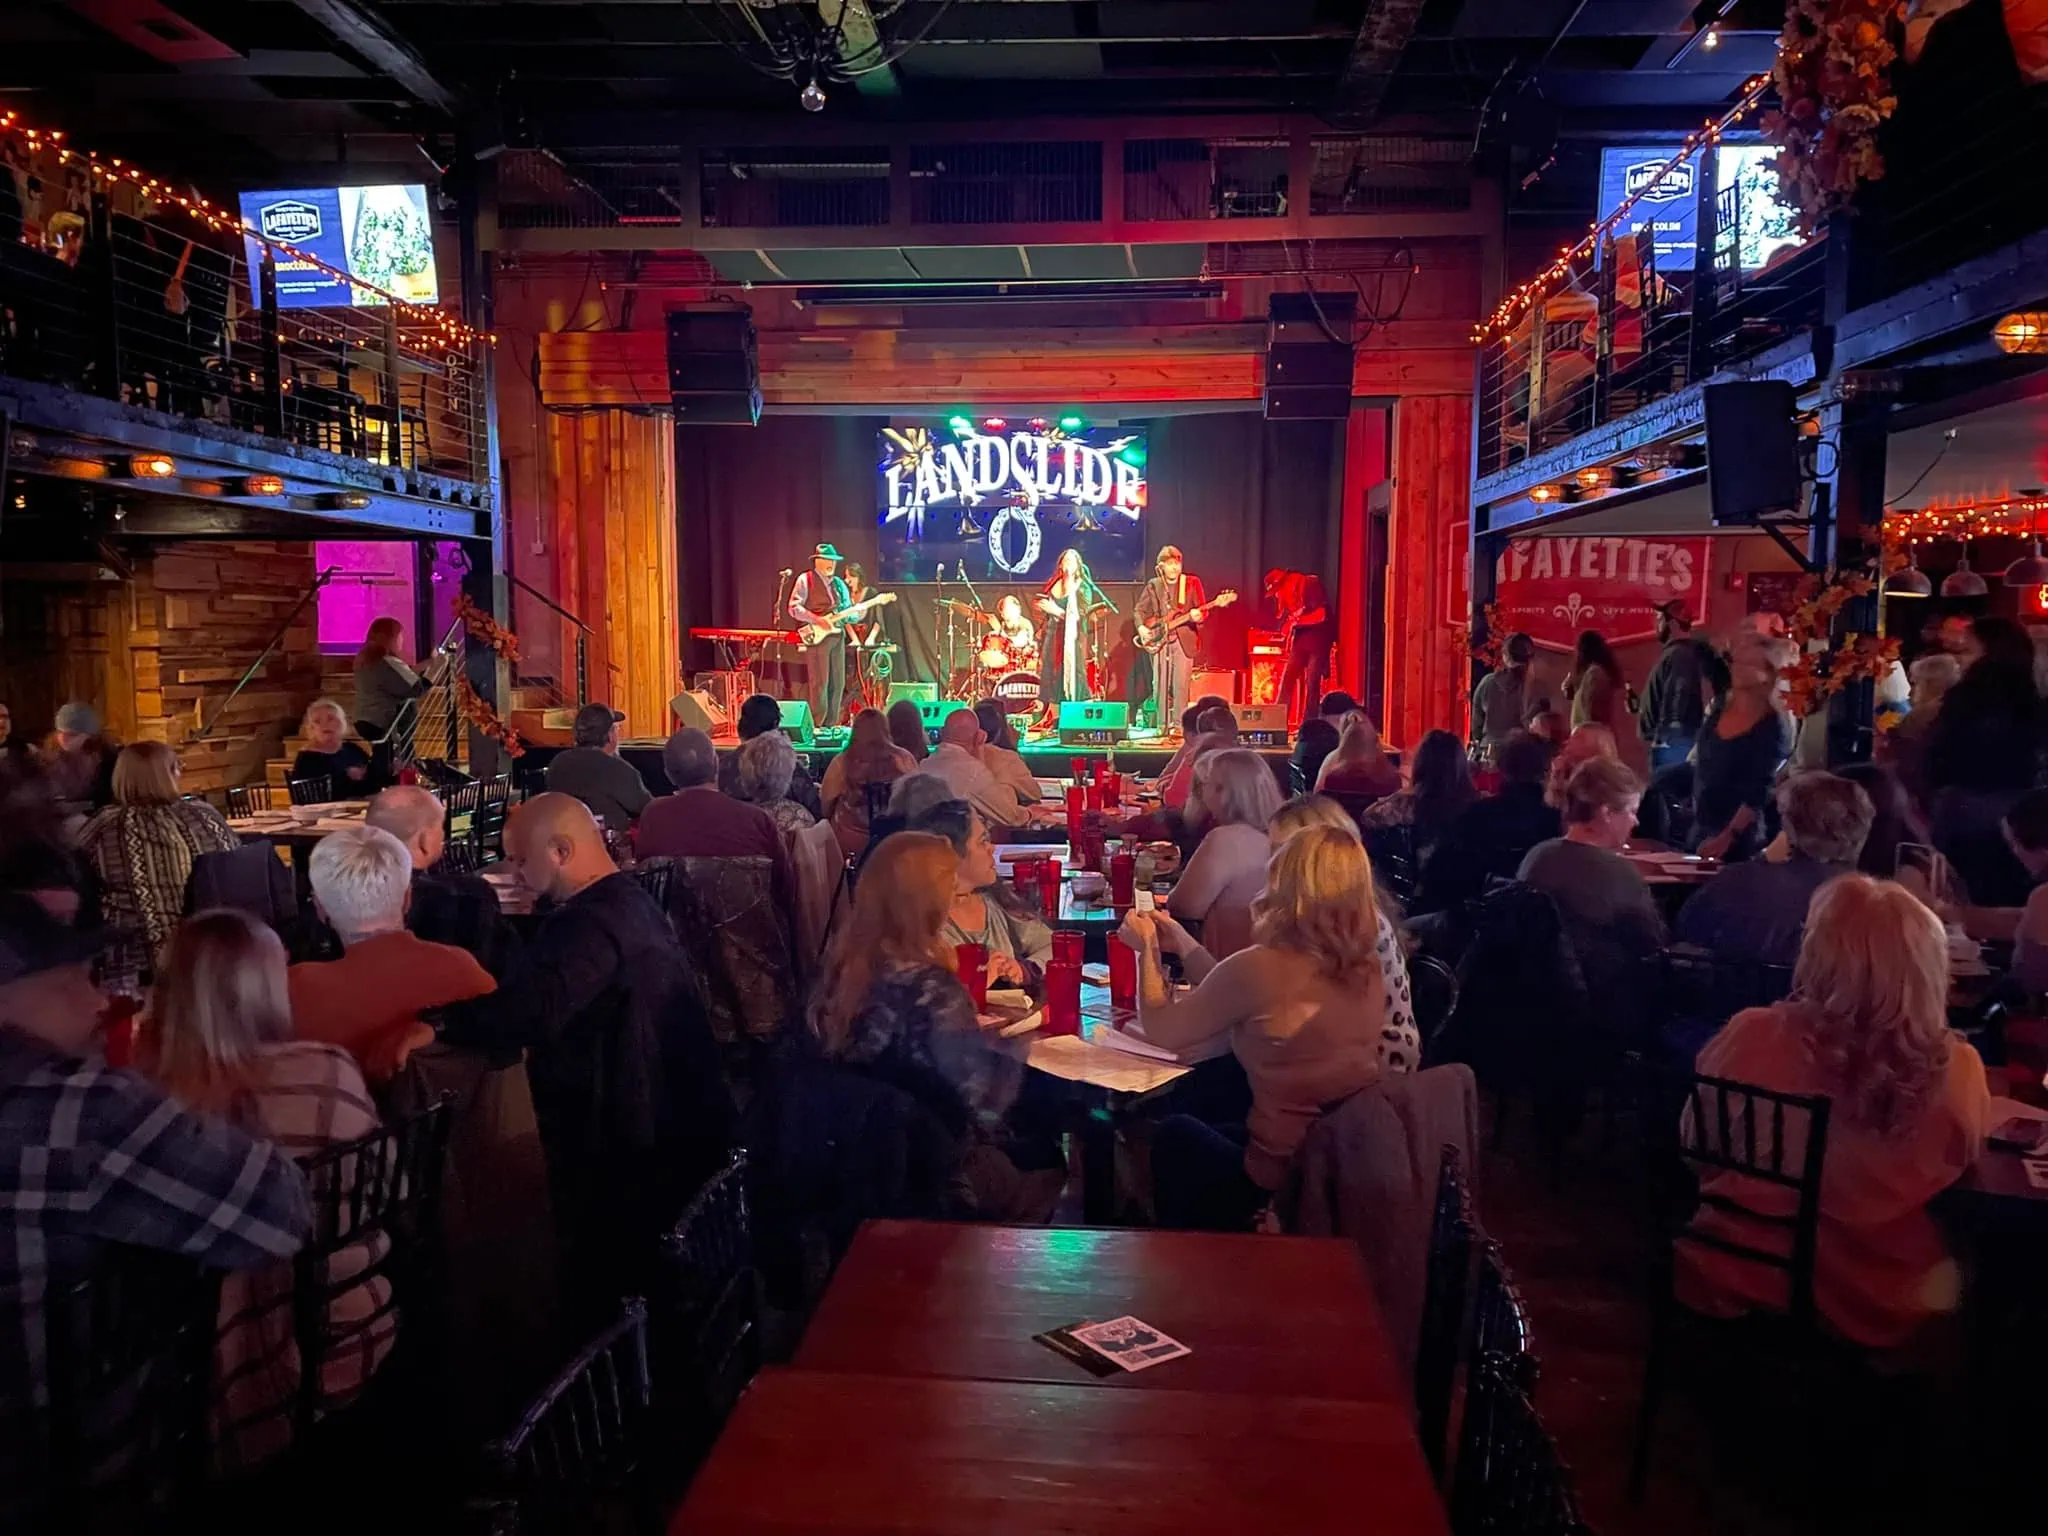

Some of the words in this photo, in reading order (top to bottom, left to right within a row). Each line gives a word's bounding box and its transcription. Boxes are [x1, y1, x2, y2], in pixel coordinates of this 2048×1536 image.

[884, 429, 1142, 523] LANDSLIDE
[1462, 537, 1694, 592] FAYETTE'S
[1602, 607, 1625, 615] LIVE
[1628, 607, 1657, 615] MUSI
